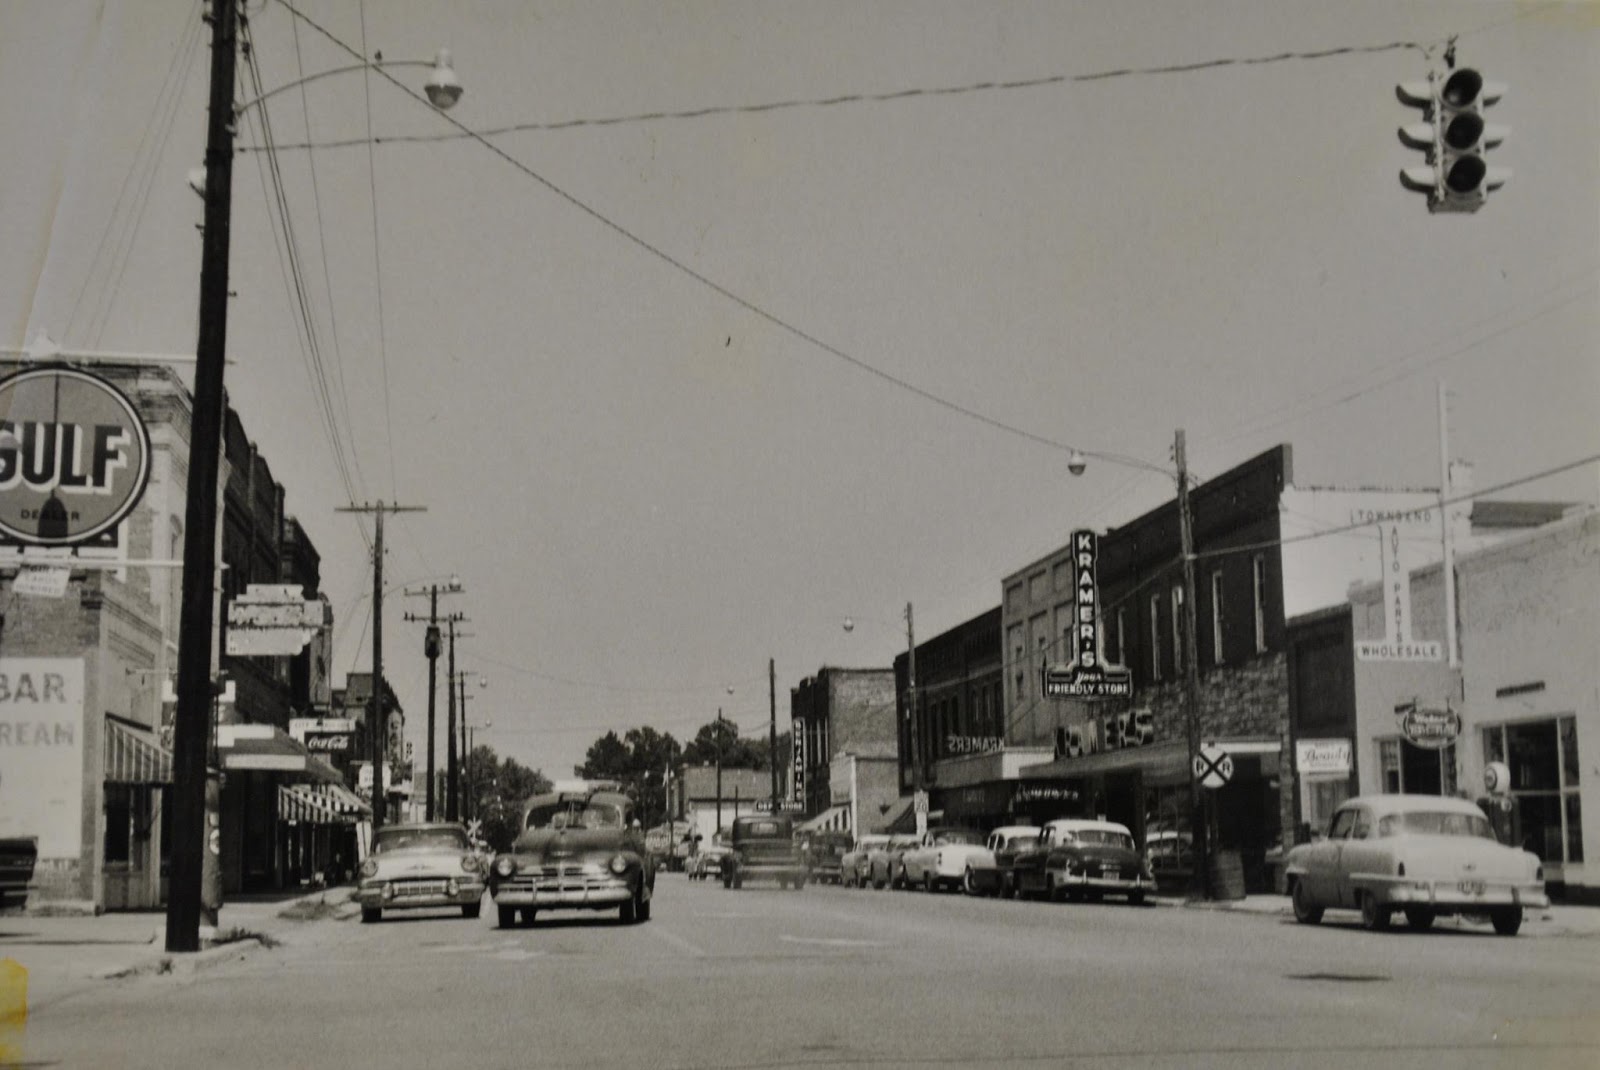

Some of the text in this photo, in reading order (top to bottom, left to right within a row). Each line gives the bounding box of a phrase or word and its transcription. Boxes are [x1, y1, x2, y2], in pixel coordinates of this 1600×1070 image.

[1078, 534, 1095, 668] KRAMER'S
[1362, 644, 1437, 658] WHOLESALE
[1048, 683, 1128, 695] FRIENDLY STORE
